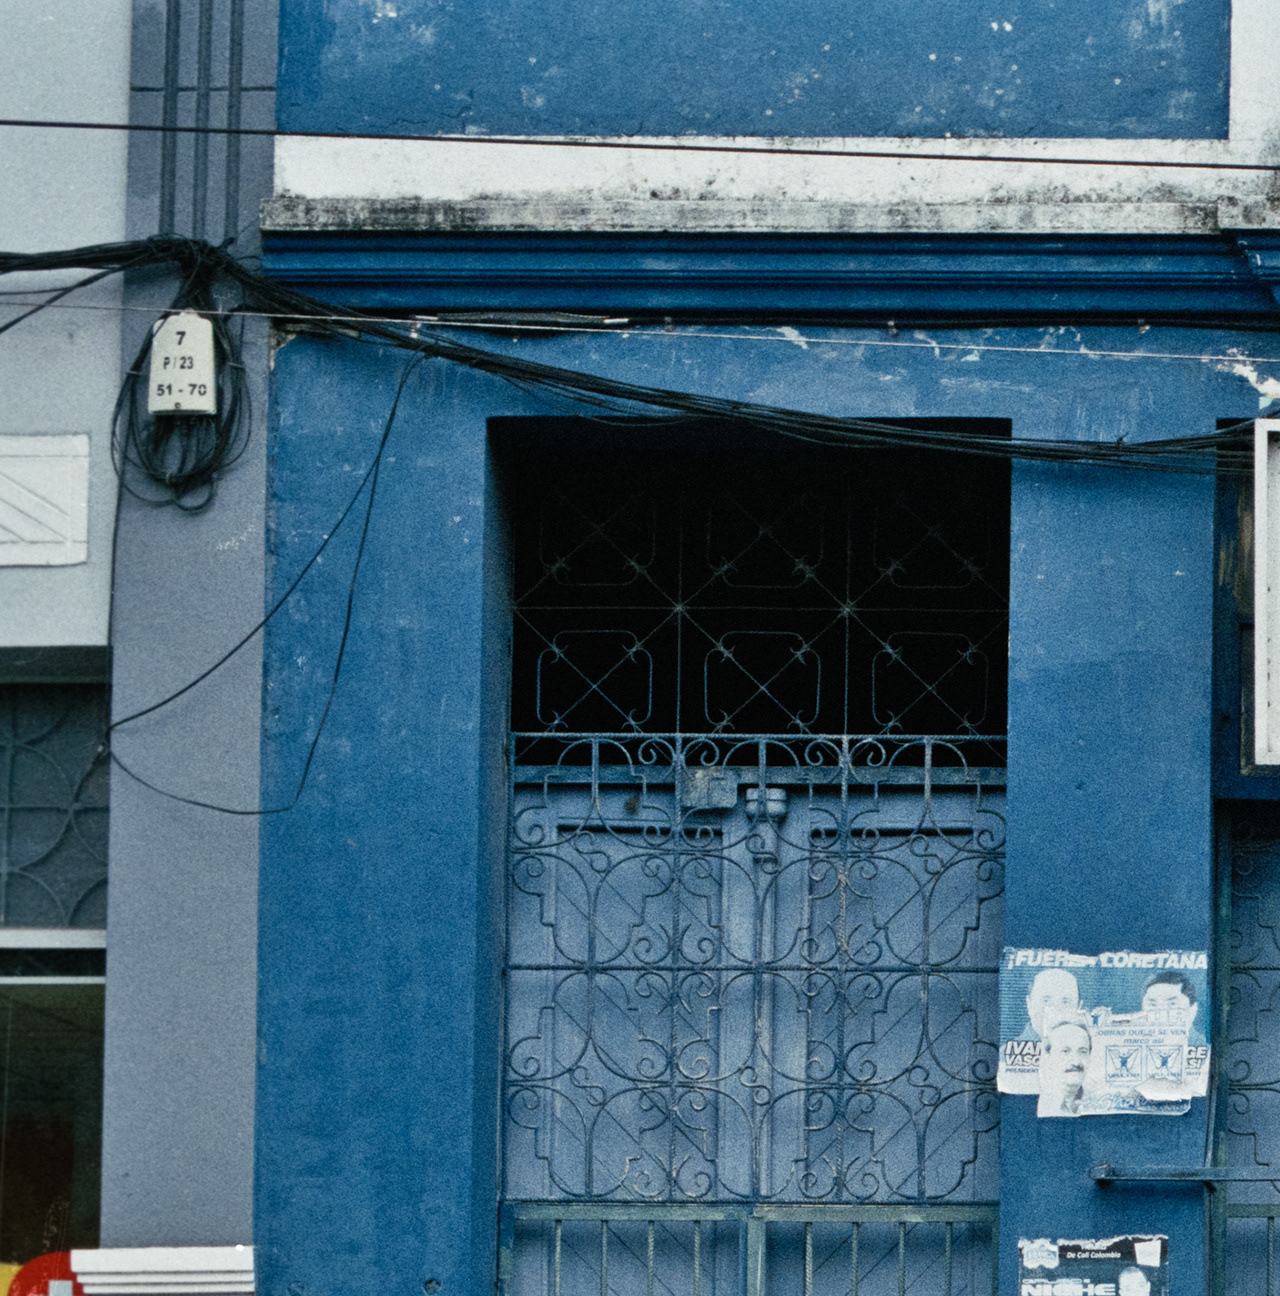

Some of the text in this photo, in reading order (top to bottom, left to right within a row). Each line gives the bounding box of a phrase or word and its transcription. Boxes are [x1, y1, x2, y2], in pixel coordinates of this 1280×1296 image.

[175, 331, 186, 345] 7
[156, 384, 172, 396] 51
[188, 383, 207, 395] 70
